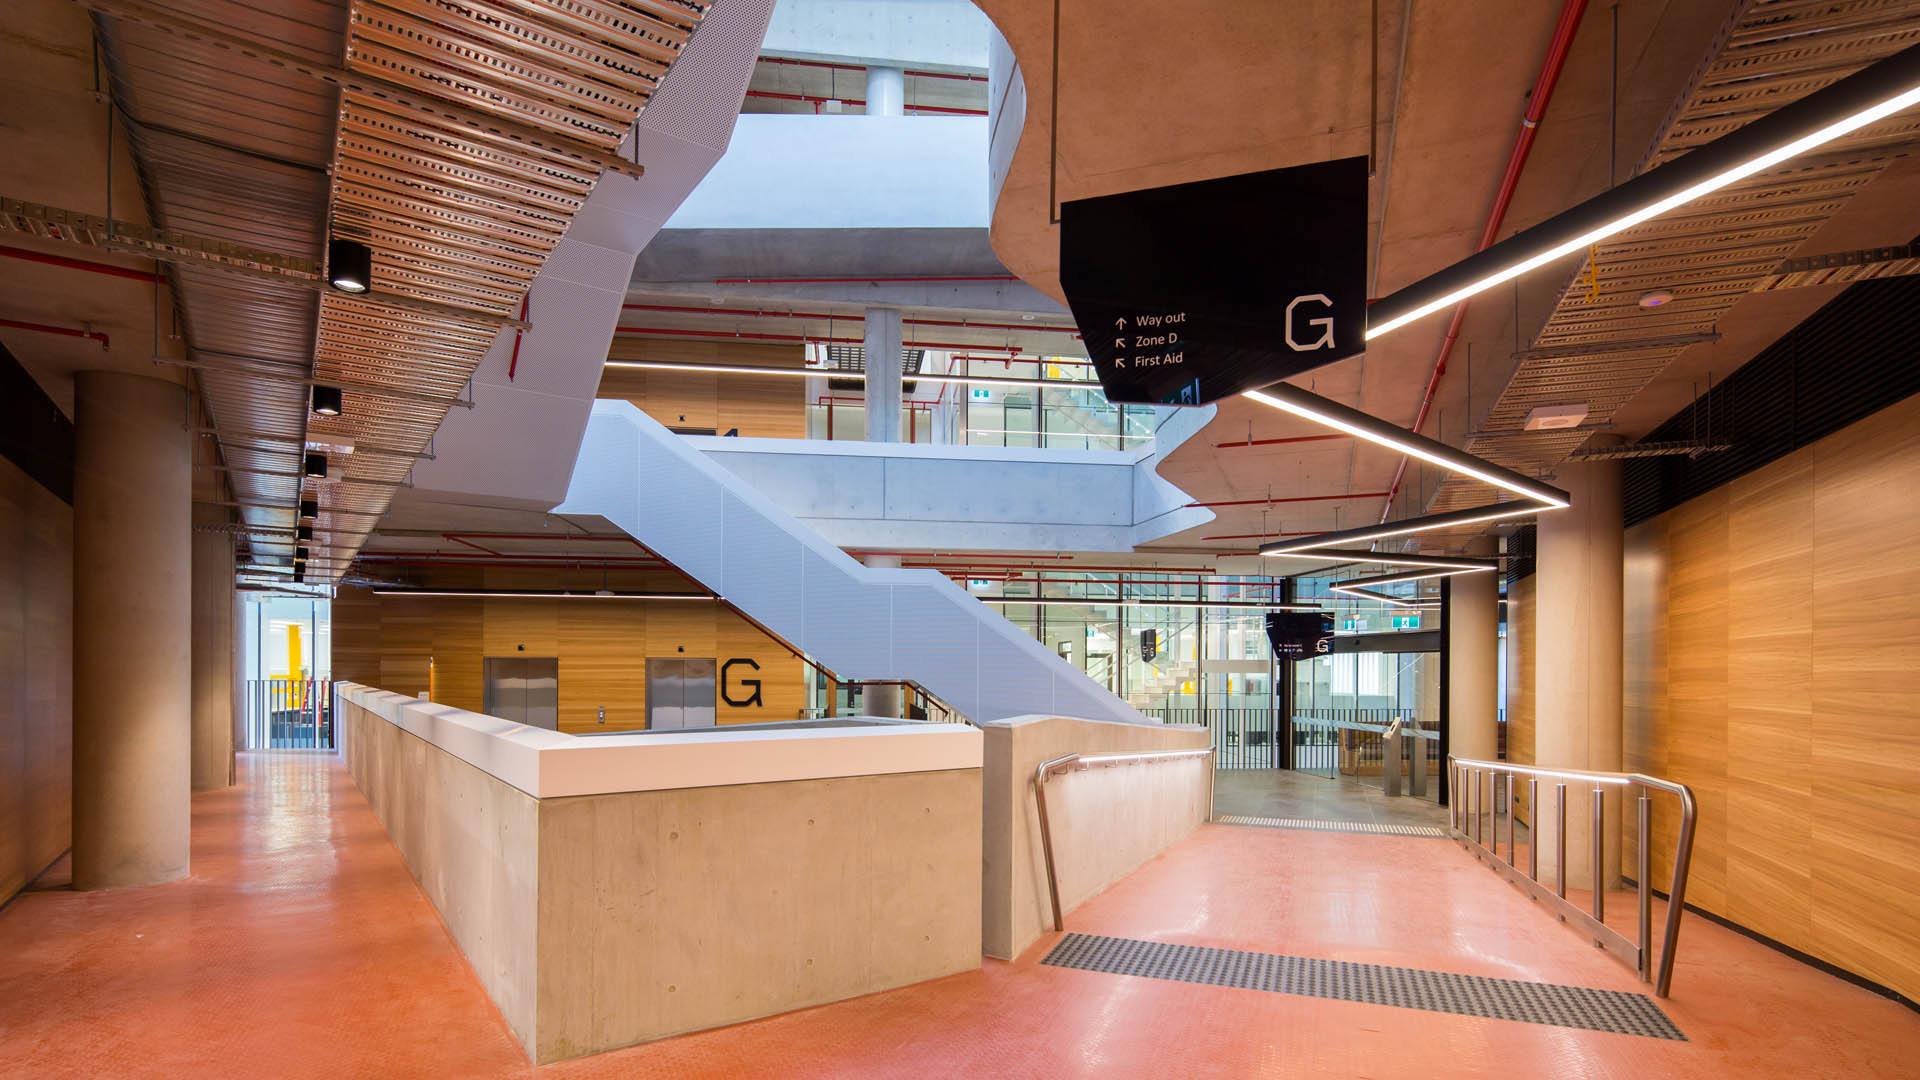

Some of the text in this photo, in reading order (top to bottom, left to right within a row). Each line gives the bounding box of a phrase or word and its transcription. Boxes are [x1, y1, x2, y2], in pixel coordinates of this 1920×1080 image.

[1136, 312, 1186, 327] Way out
[1285, 293, 1336, 352] G
[1135, 332, 1178, 348] Zone D
[1135, 351, 1183, 368] First Aid
[1317, 640, 1329, 652] G
[721, 658, 763, 707] G
